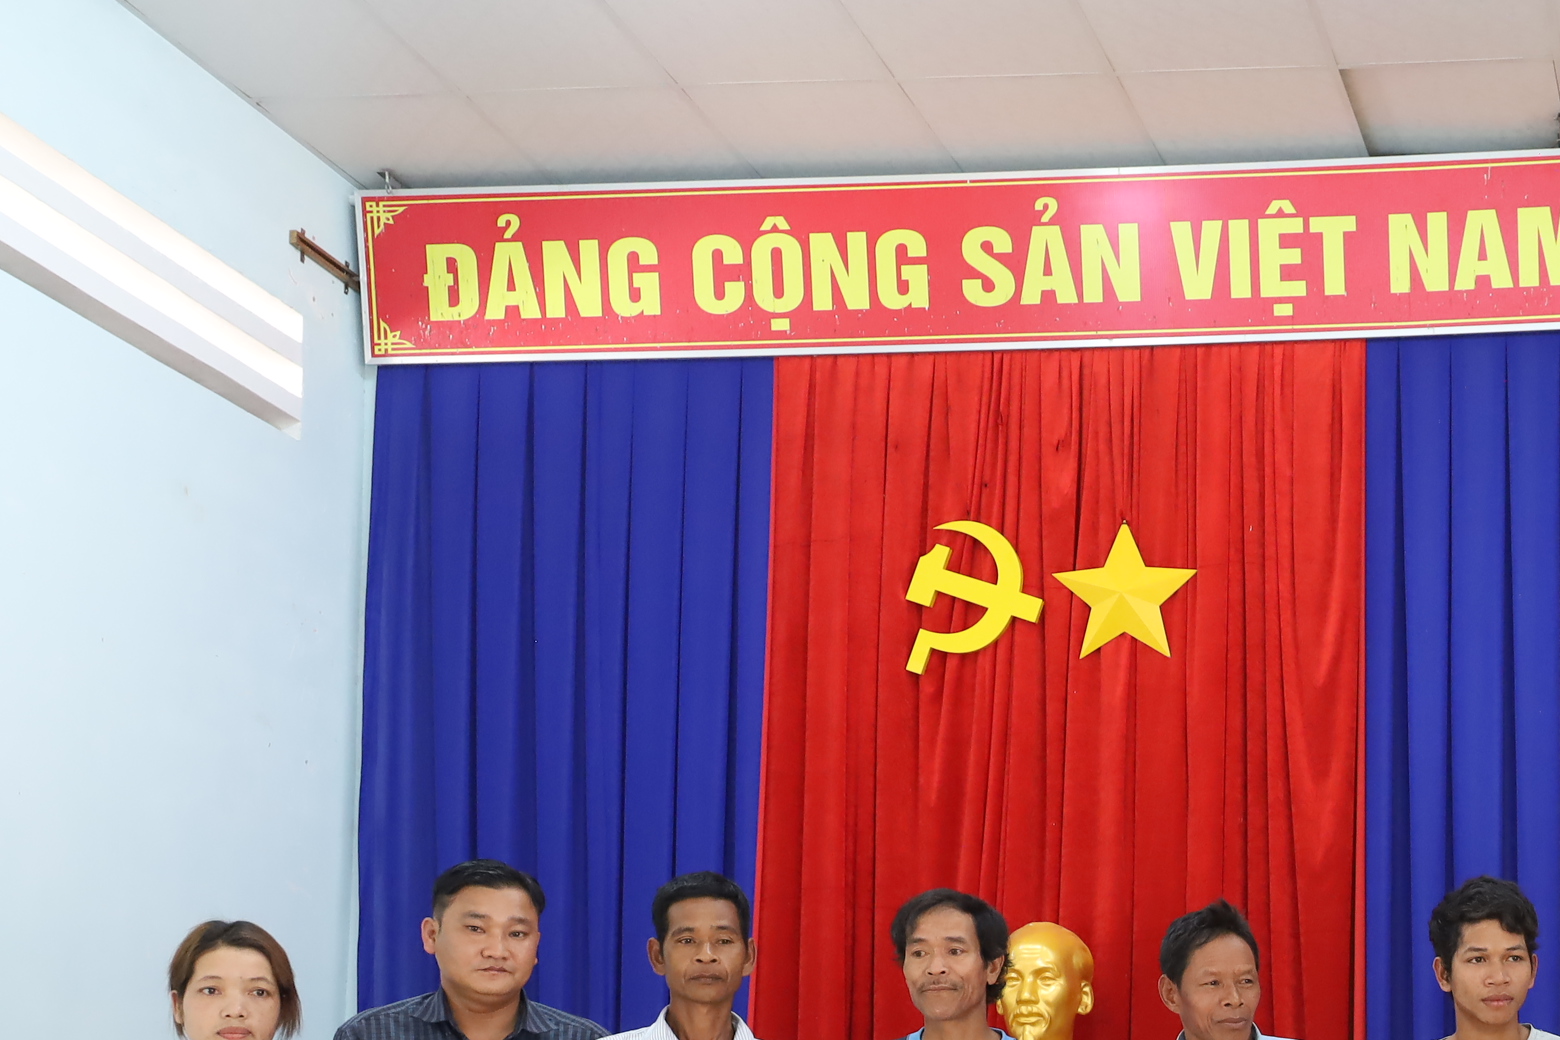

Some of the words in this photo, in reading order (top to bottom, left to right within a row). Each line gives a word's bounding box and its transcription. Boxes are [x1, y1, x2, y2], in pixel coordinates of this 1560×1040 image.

[423, 214, 661, 321] ĐẢNG
[692, 216, 929, 330] CỘNG
[962, 197, 1142, 307] SẢN
[1170, 199, 1357, 316] VIỆT
